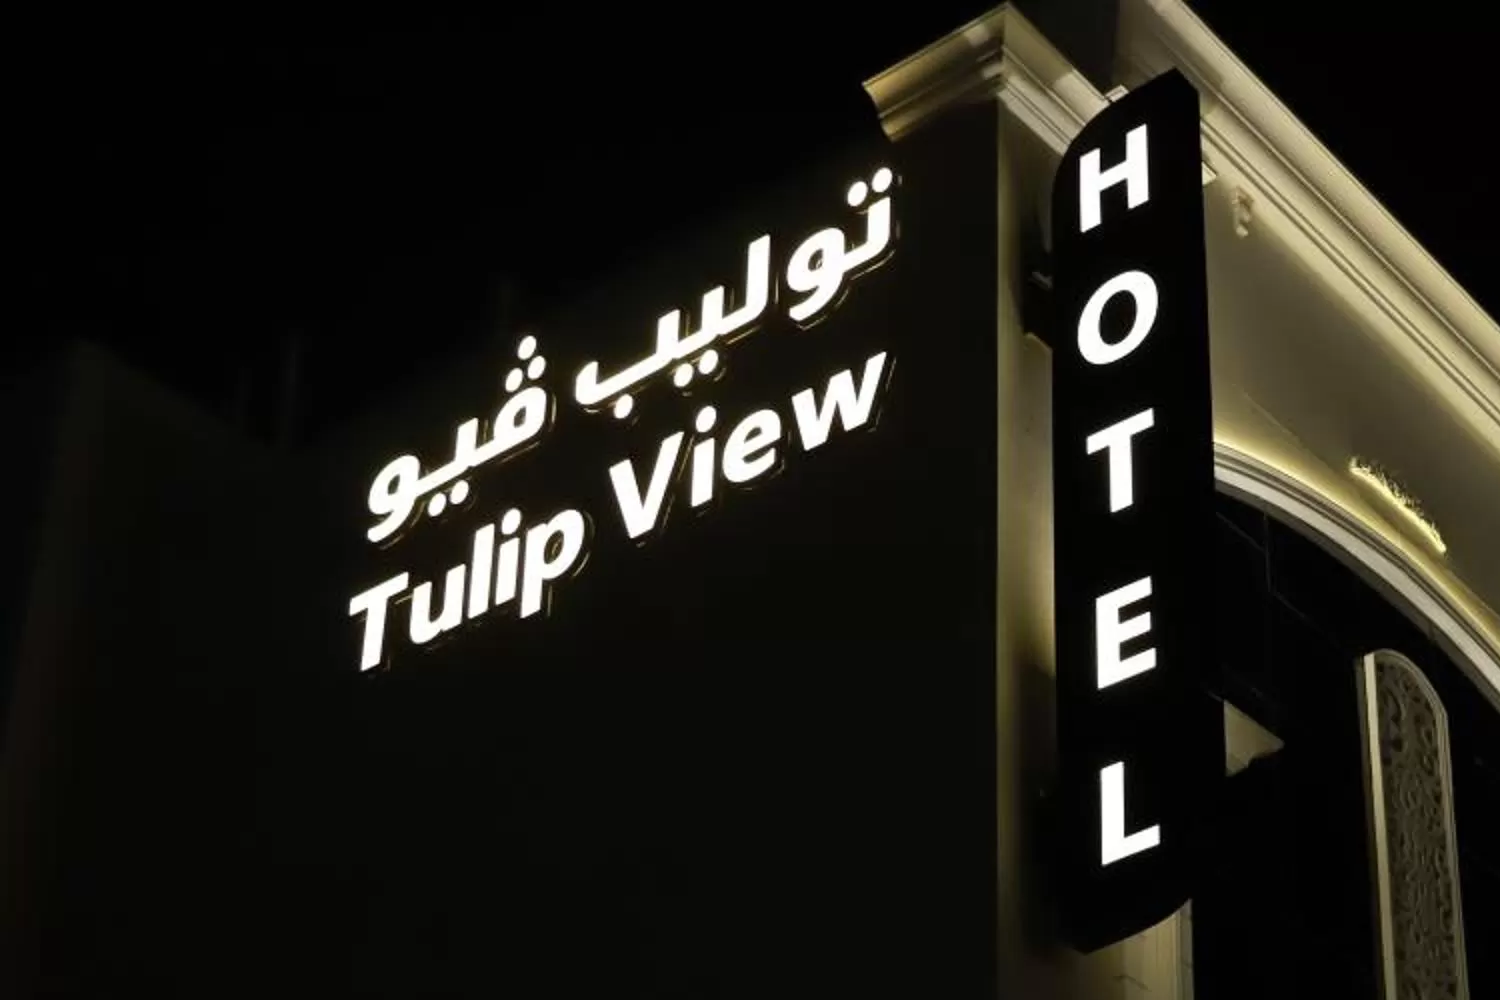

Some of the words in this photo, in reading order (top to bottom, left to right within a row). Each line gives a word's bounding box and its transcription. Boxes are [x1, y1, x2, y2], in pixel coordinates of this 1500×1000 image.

[575, 166, 894, 420] توليب
[348, 507, 586, 672] Tulip
[608, 350, 888, 540] View
[1077, 123, 1162, 866] HOTEL
